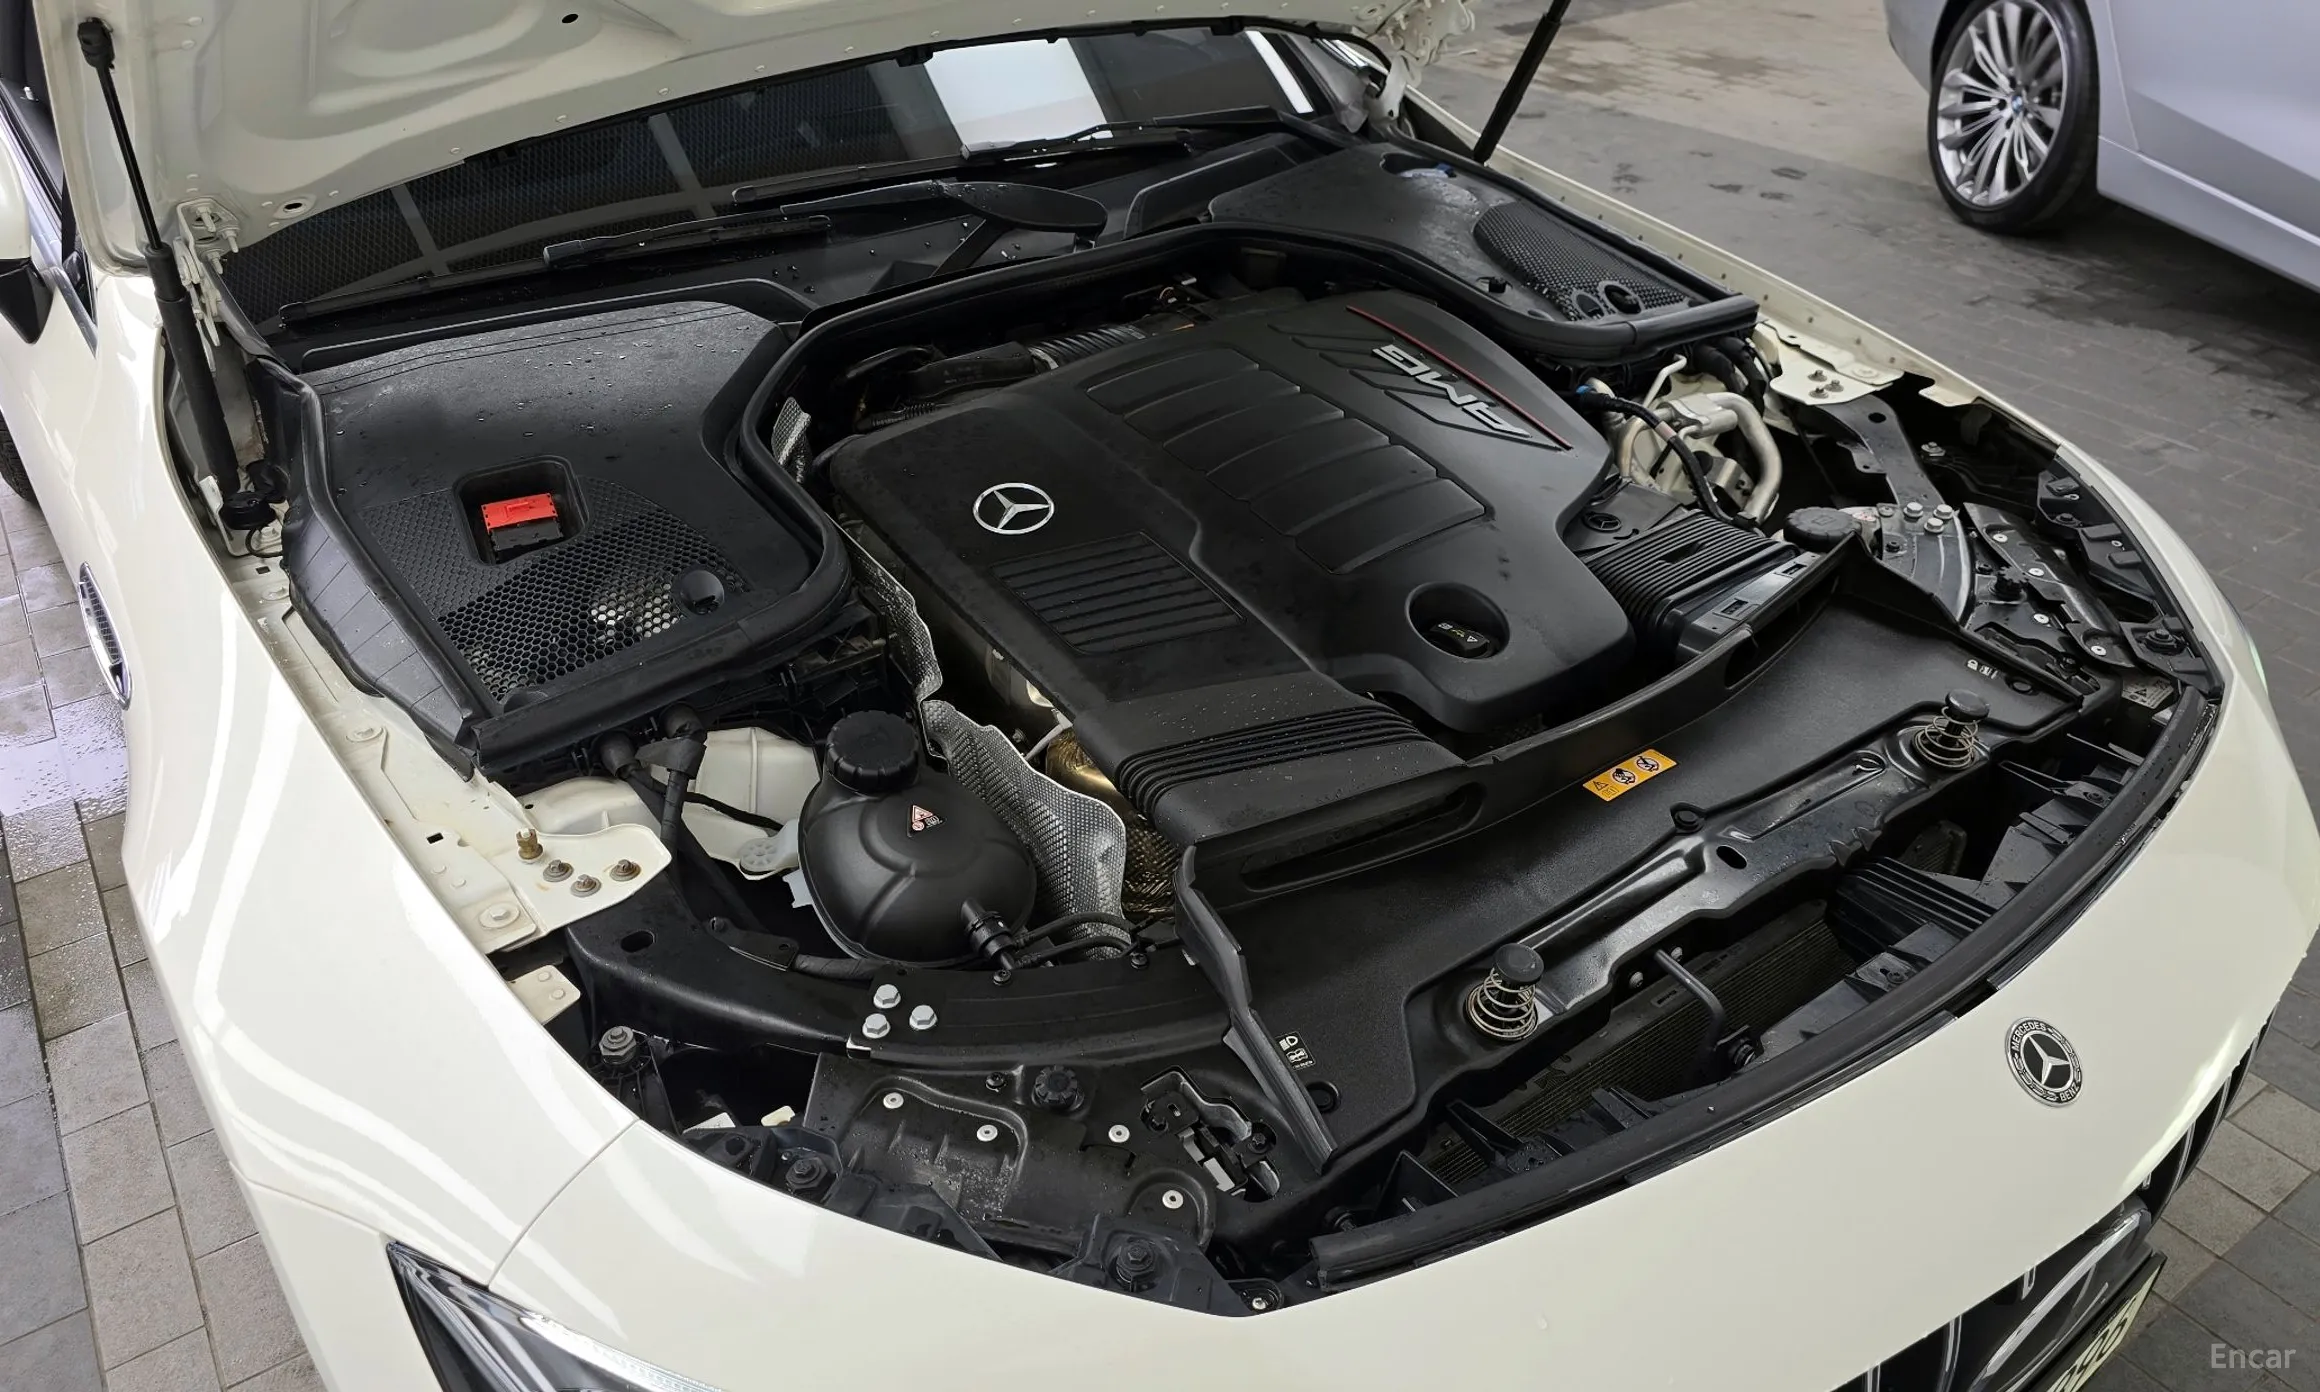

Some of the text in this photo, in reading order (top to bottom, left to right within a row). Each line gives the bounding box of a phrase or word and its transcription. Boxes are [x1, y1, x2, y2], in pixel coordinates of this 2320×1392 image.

[1371, 344, 1531, 438] AMG
[2011, 1021, 2047, 1052] MERCEDES
[2060, 1082, 2080, 1101] BENZ
